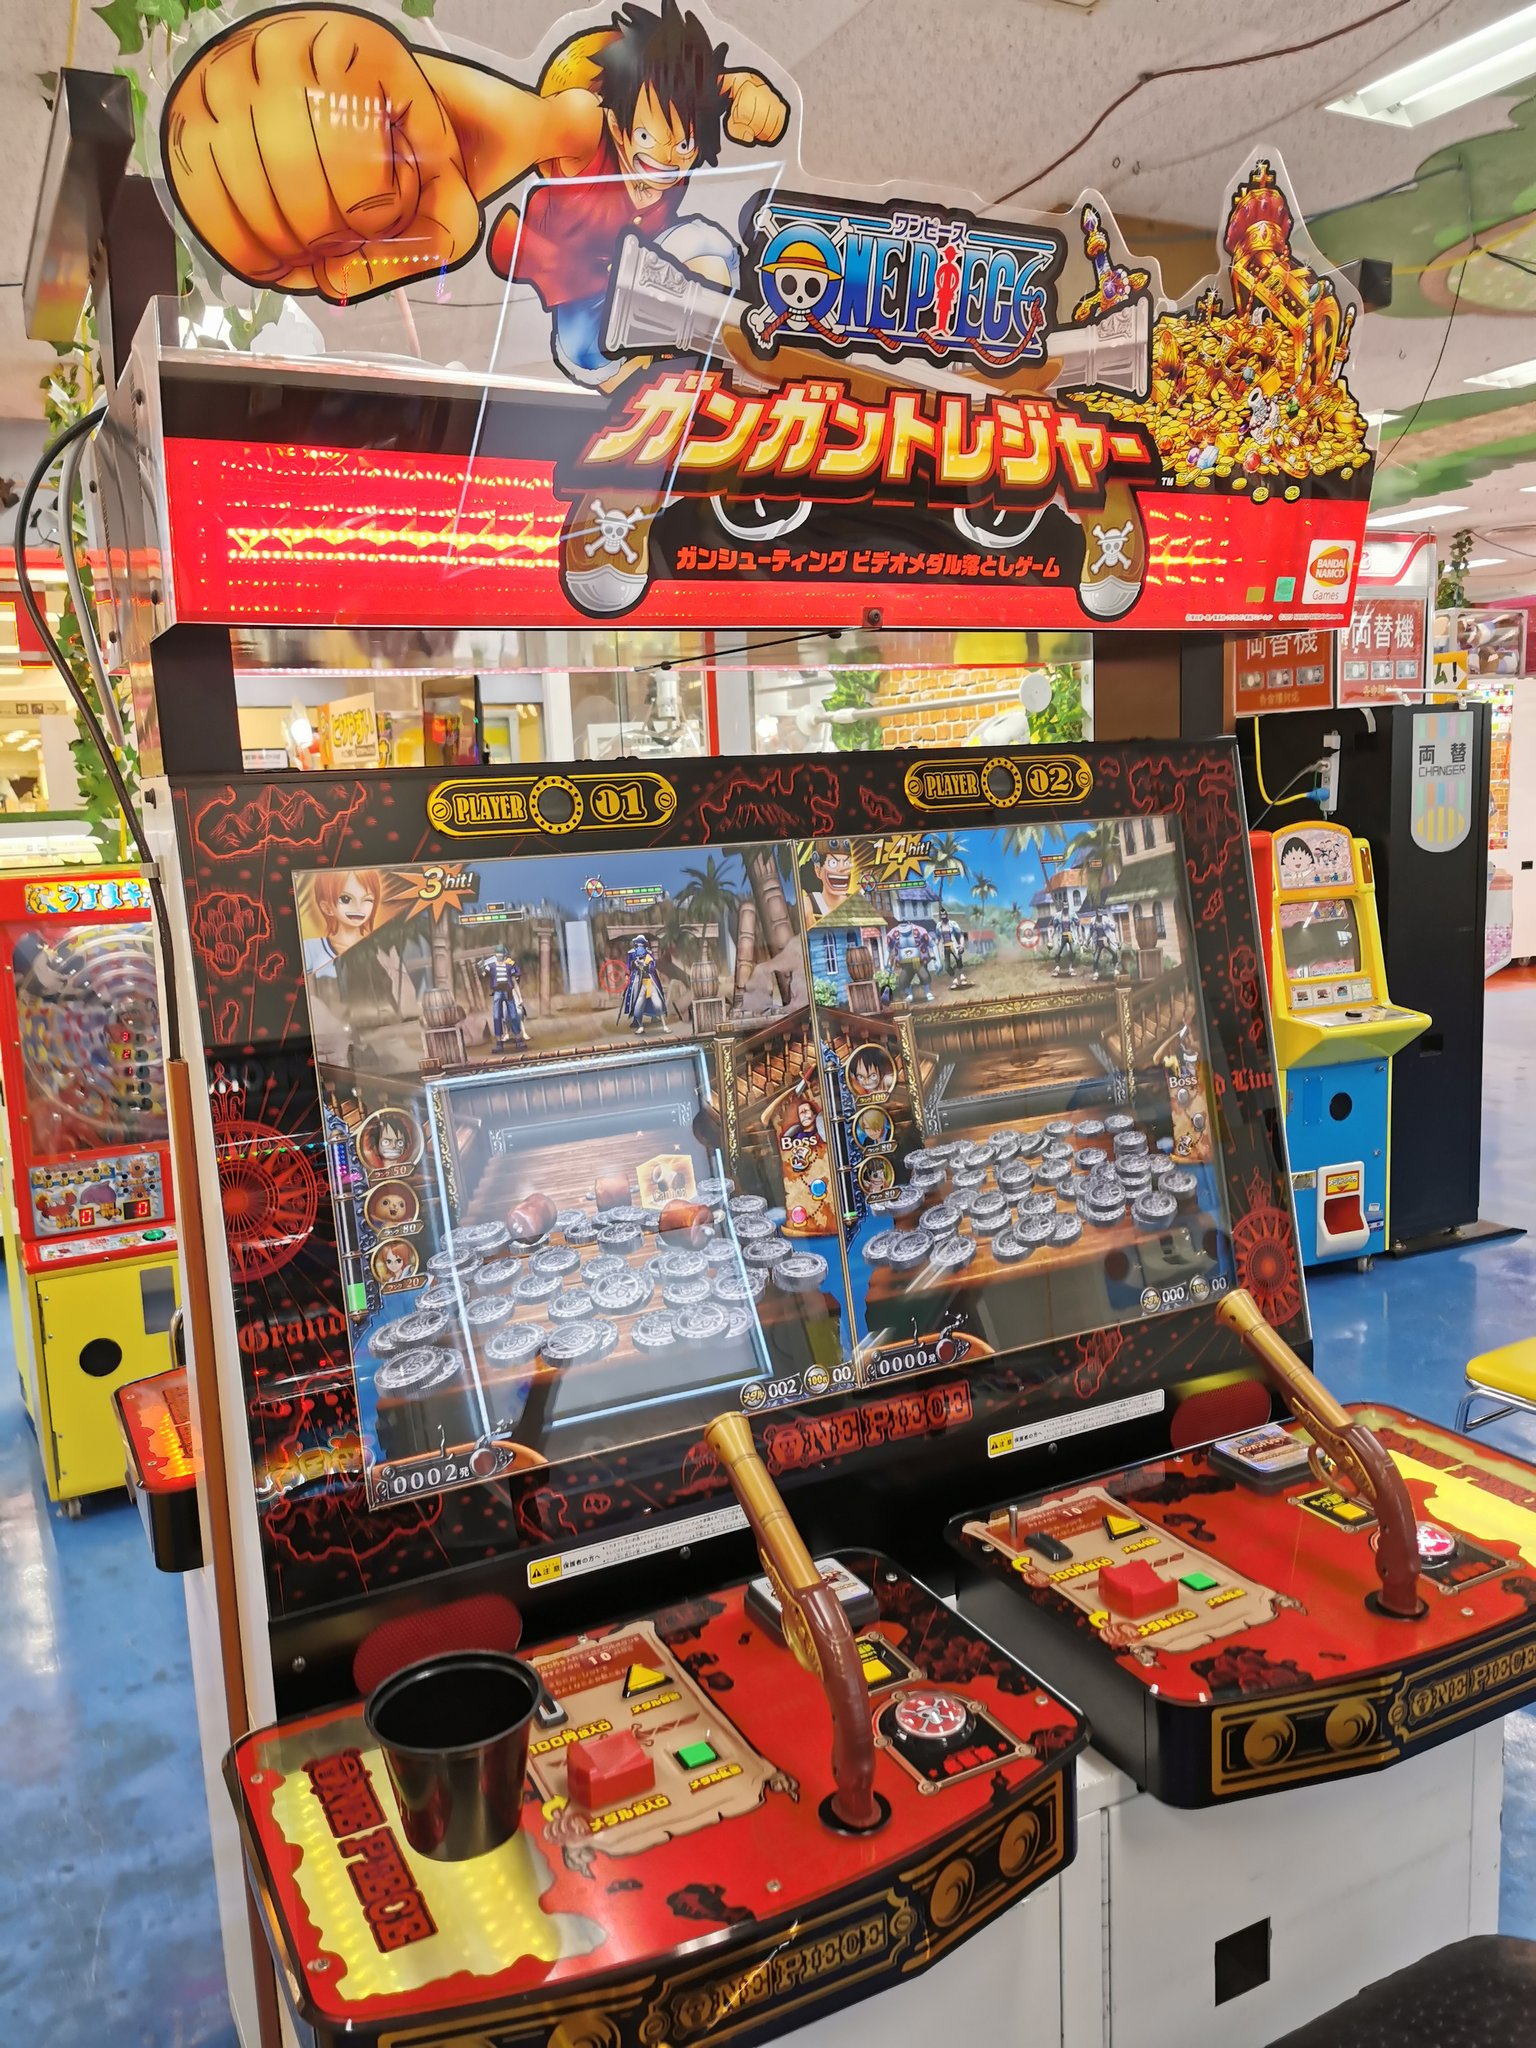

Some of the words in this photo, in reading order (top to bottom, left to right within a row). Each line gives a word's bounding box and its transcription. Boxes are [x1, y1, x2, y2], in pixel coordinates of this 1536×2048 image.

[893, 214, 967, 244] ワンピース
[584, 377, 1149, 487] ガンガントレジャー
[677, 546, 847, 574] ガンシューティング
[852, 551, 1060, 578] ビデオメダル落としゲーム
[1317, 558, 1347, 569] BANDAI
[1315, 568, 1345, 579] NAMCO
[1312, 589, 1339, 602] Games
[1419, 742, 1466, 765] 両替
[1419, 764, 1466, 777] CHANGER
[924, 771, 979, 798] PLAYER
[1027, 764, 1072, 794] 02
[454, 792, 526, 824] PLAYER
[593, 783, 648, 820] 01
[908, 841, 931, 858] hit!
[419, 866, 445, 900] 3
[444, 872, 474, 890] hit!
[1169, 1076, 1197, 1089] Boss
[781, 1134, 818, 1151] Boss
[393, 1165, 407, 1176] 50
[81, 1210, 92, 1224] 0
[402, 1224, 416, 1234] 80
[406, 1278, 420, 1289] 20
[1212, 1277, 1226, 1290] 00
[1162, 1286, 1184, 1303] 000
[238, 1305, 347, 1353] Grand
[768, 1382, 797, 1399] 002
[864, 1381, 973, 1447] PIECE
[563, 1554, 600, 1570] 保護者の方へ
[589, 1650, 612, 1666] 10
[774, 1913, 887, 1993] PIECE
